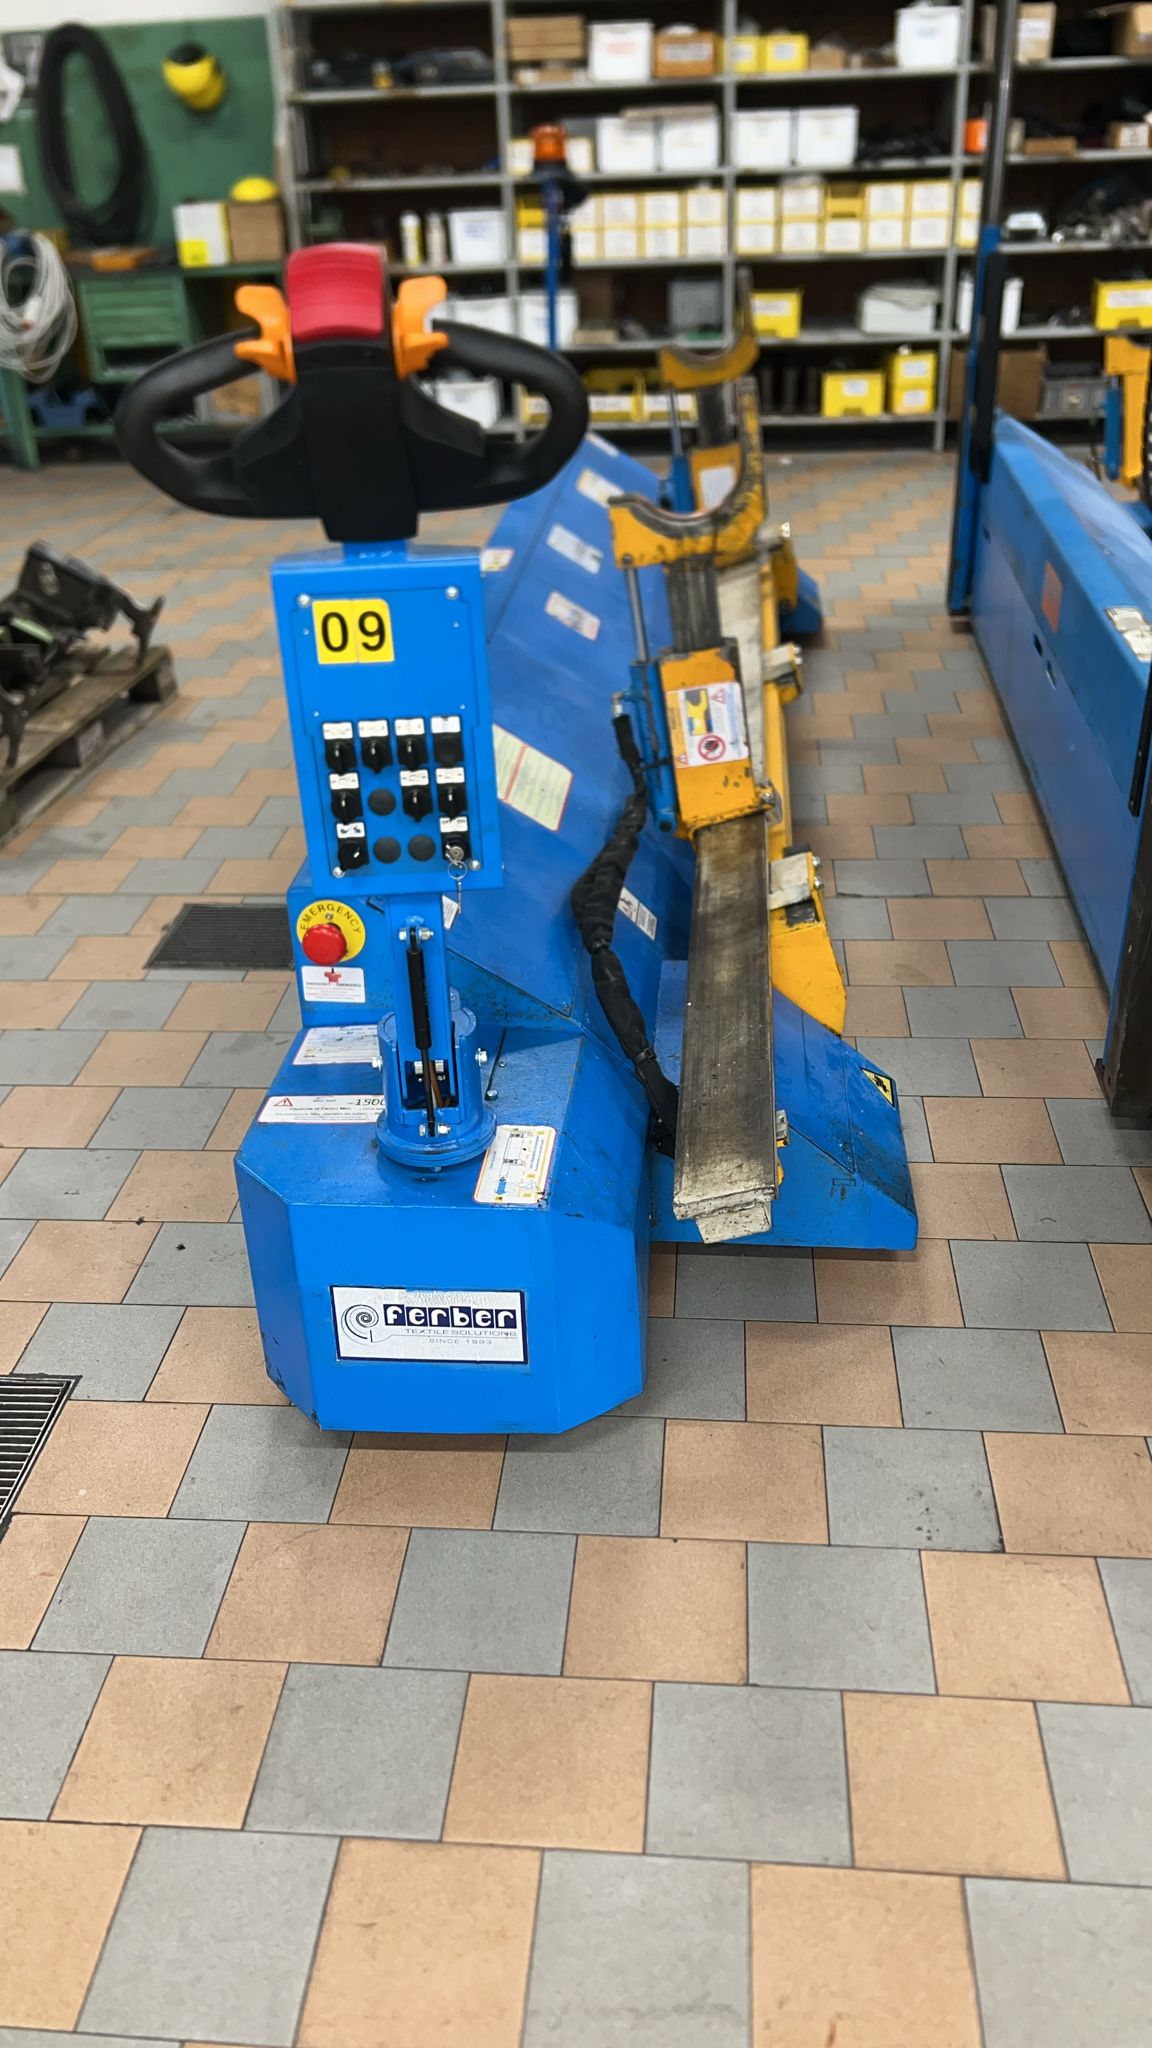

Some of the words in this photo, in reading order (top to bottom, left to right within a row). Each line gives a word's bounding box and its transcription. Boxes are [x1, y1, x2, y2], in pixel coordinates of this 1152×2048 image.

[321, 610, 386, 653] 09
[300, 903, 362, 934] EMERGENCY
[385, 1304, 516, 1329] ferber
[451, 1329, 518, 1337] SOLUTIONS
